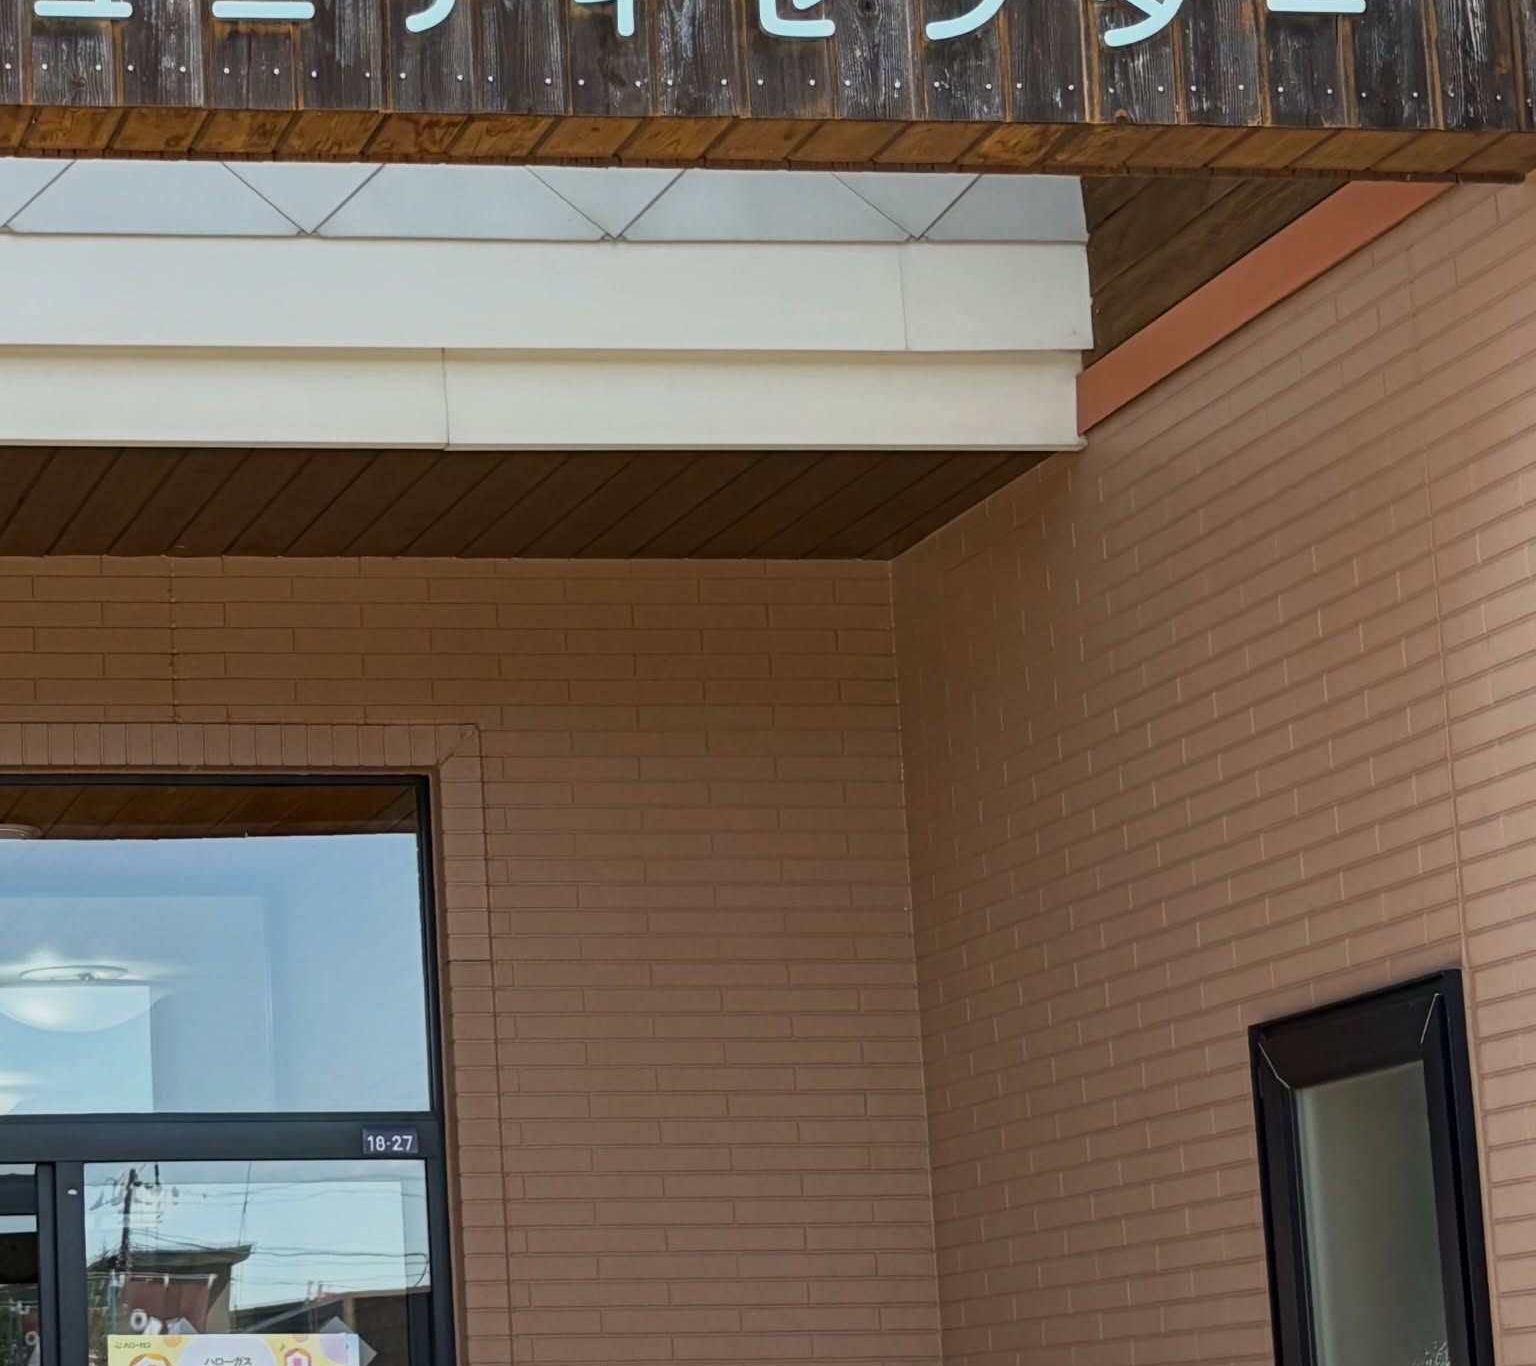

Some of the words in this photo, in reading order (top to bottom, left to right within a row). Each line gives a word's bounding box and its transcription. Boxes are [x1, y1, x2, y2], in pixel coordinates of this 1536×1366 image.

[204, 1356, 252, 1366] ハローガス
